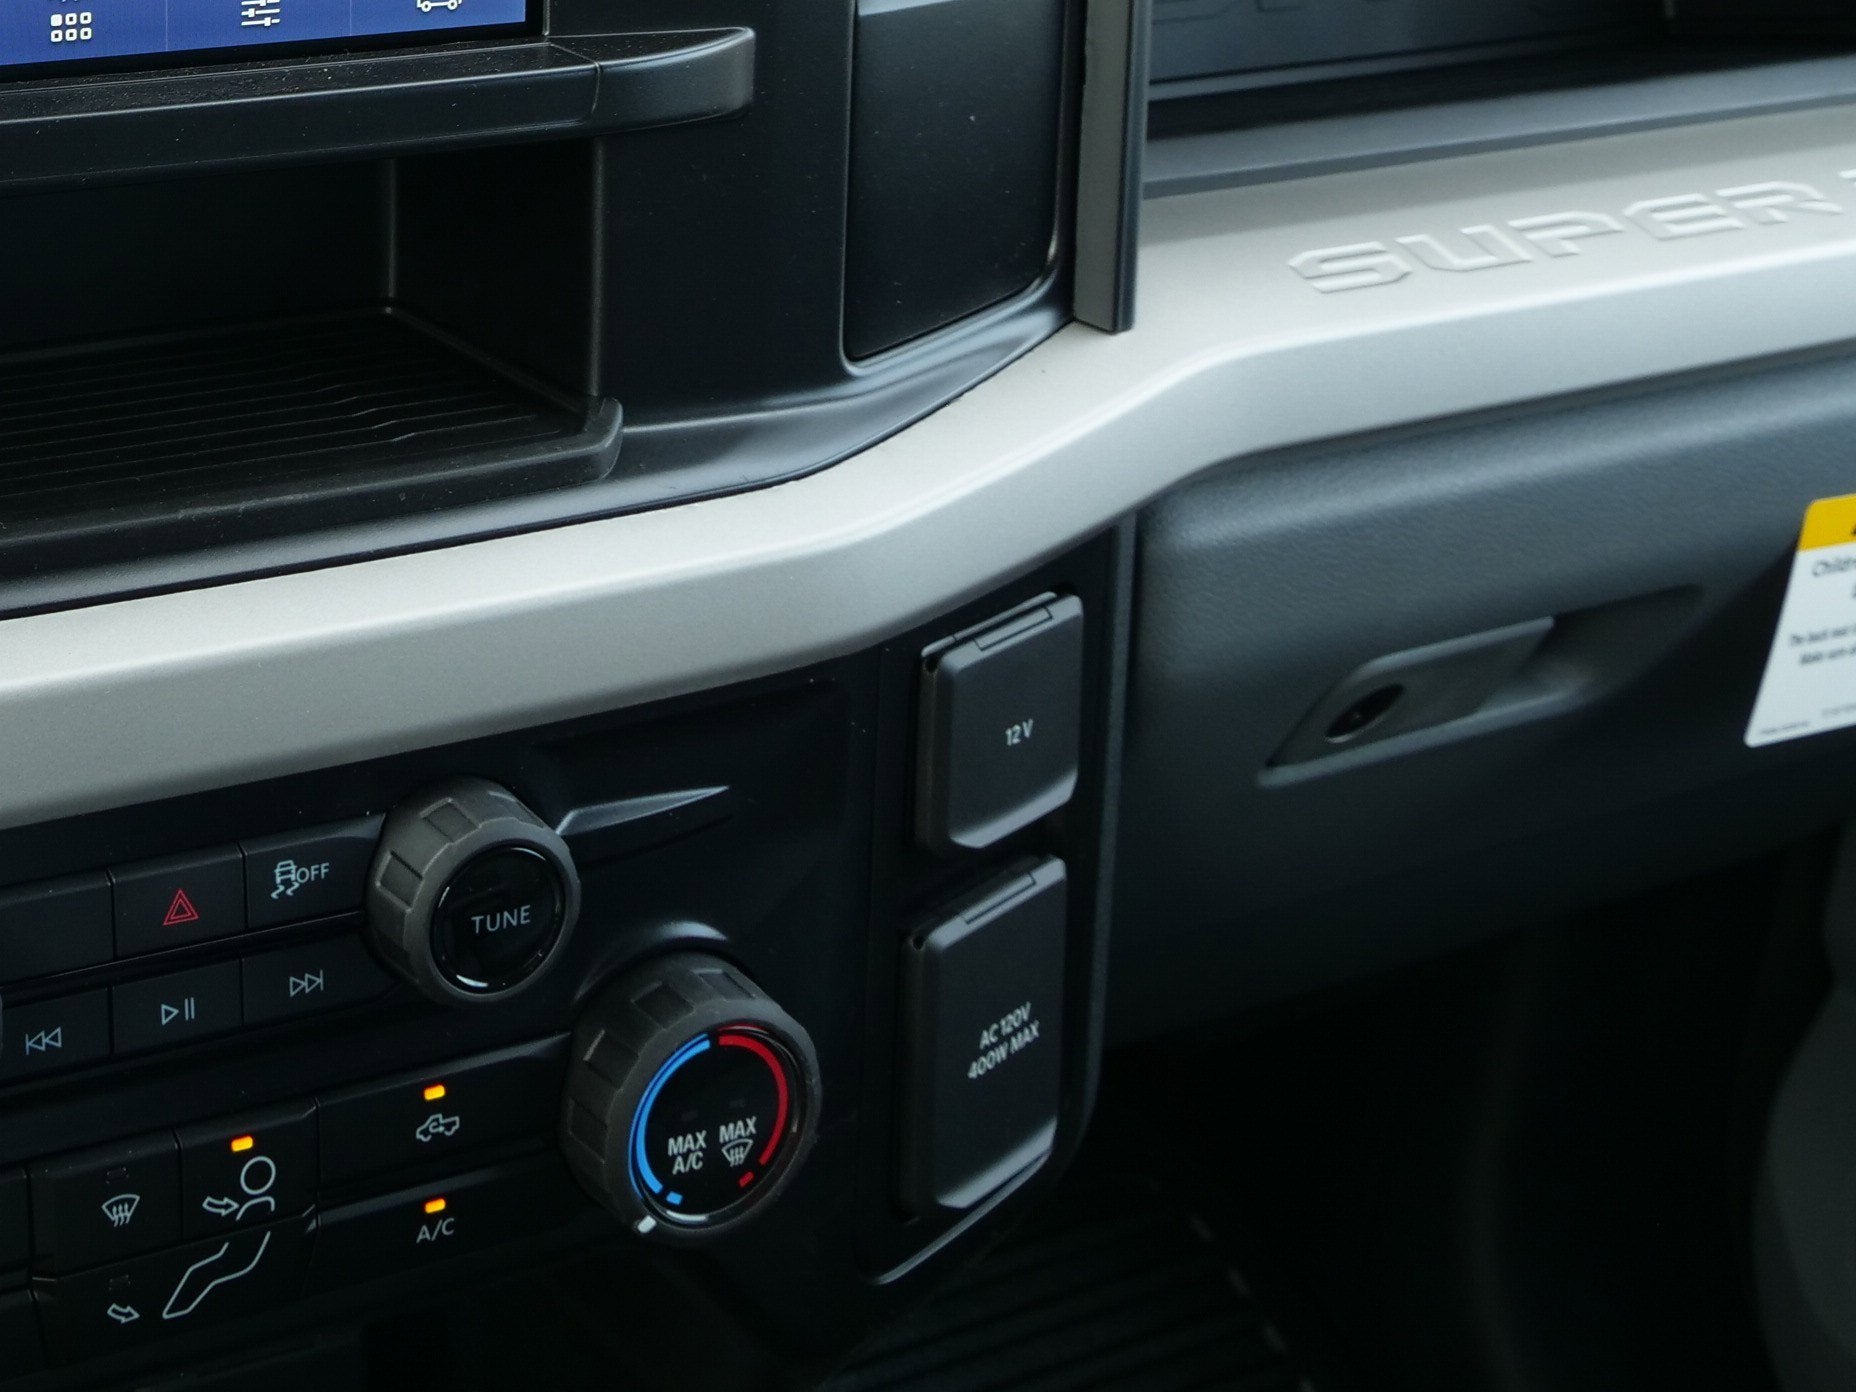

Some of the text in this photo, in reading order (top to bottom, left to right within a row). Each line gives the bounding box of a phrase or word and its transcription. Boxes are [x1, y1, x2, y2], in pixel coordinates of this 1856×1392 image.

[1288, 180, 1845, 295] SUPER
[1004, 718, 1035, 746] 12V
[296, 861, 330, 884] OFF
[471, 904, 532, 934] TUNE
[979, 1001, 1032, 1050] AC 120V
[967, 1019, 1041, 1079] 400W MAX
[667, 1130, 707, 1157] MAX
[719, 1115, 757, 1144] MAX
[672, 1150, 704, 1175] A/C
[416, 1218, 455, 1244] A/C
